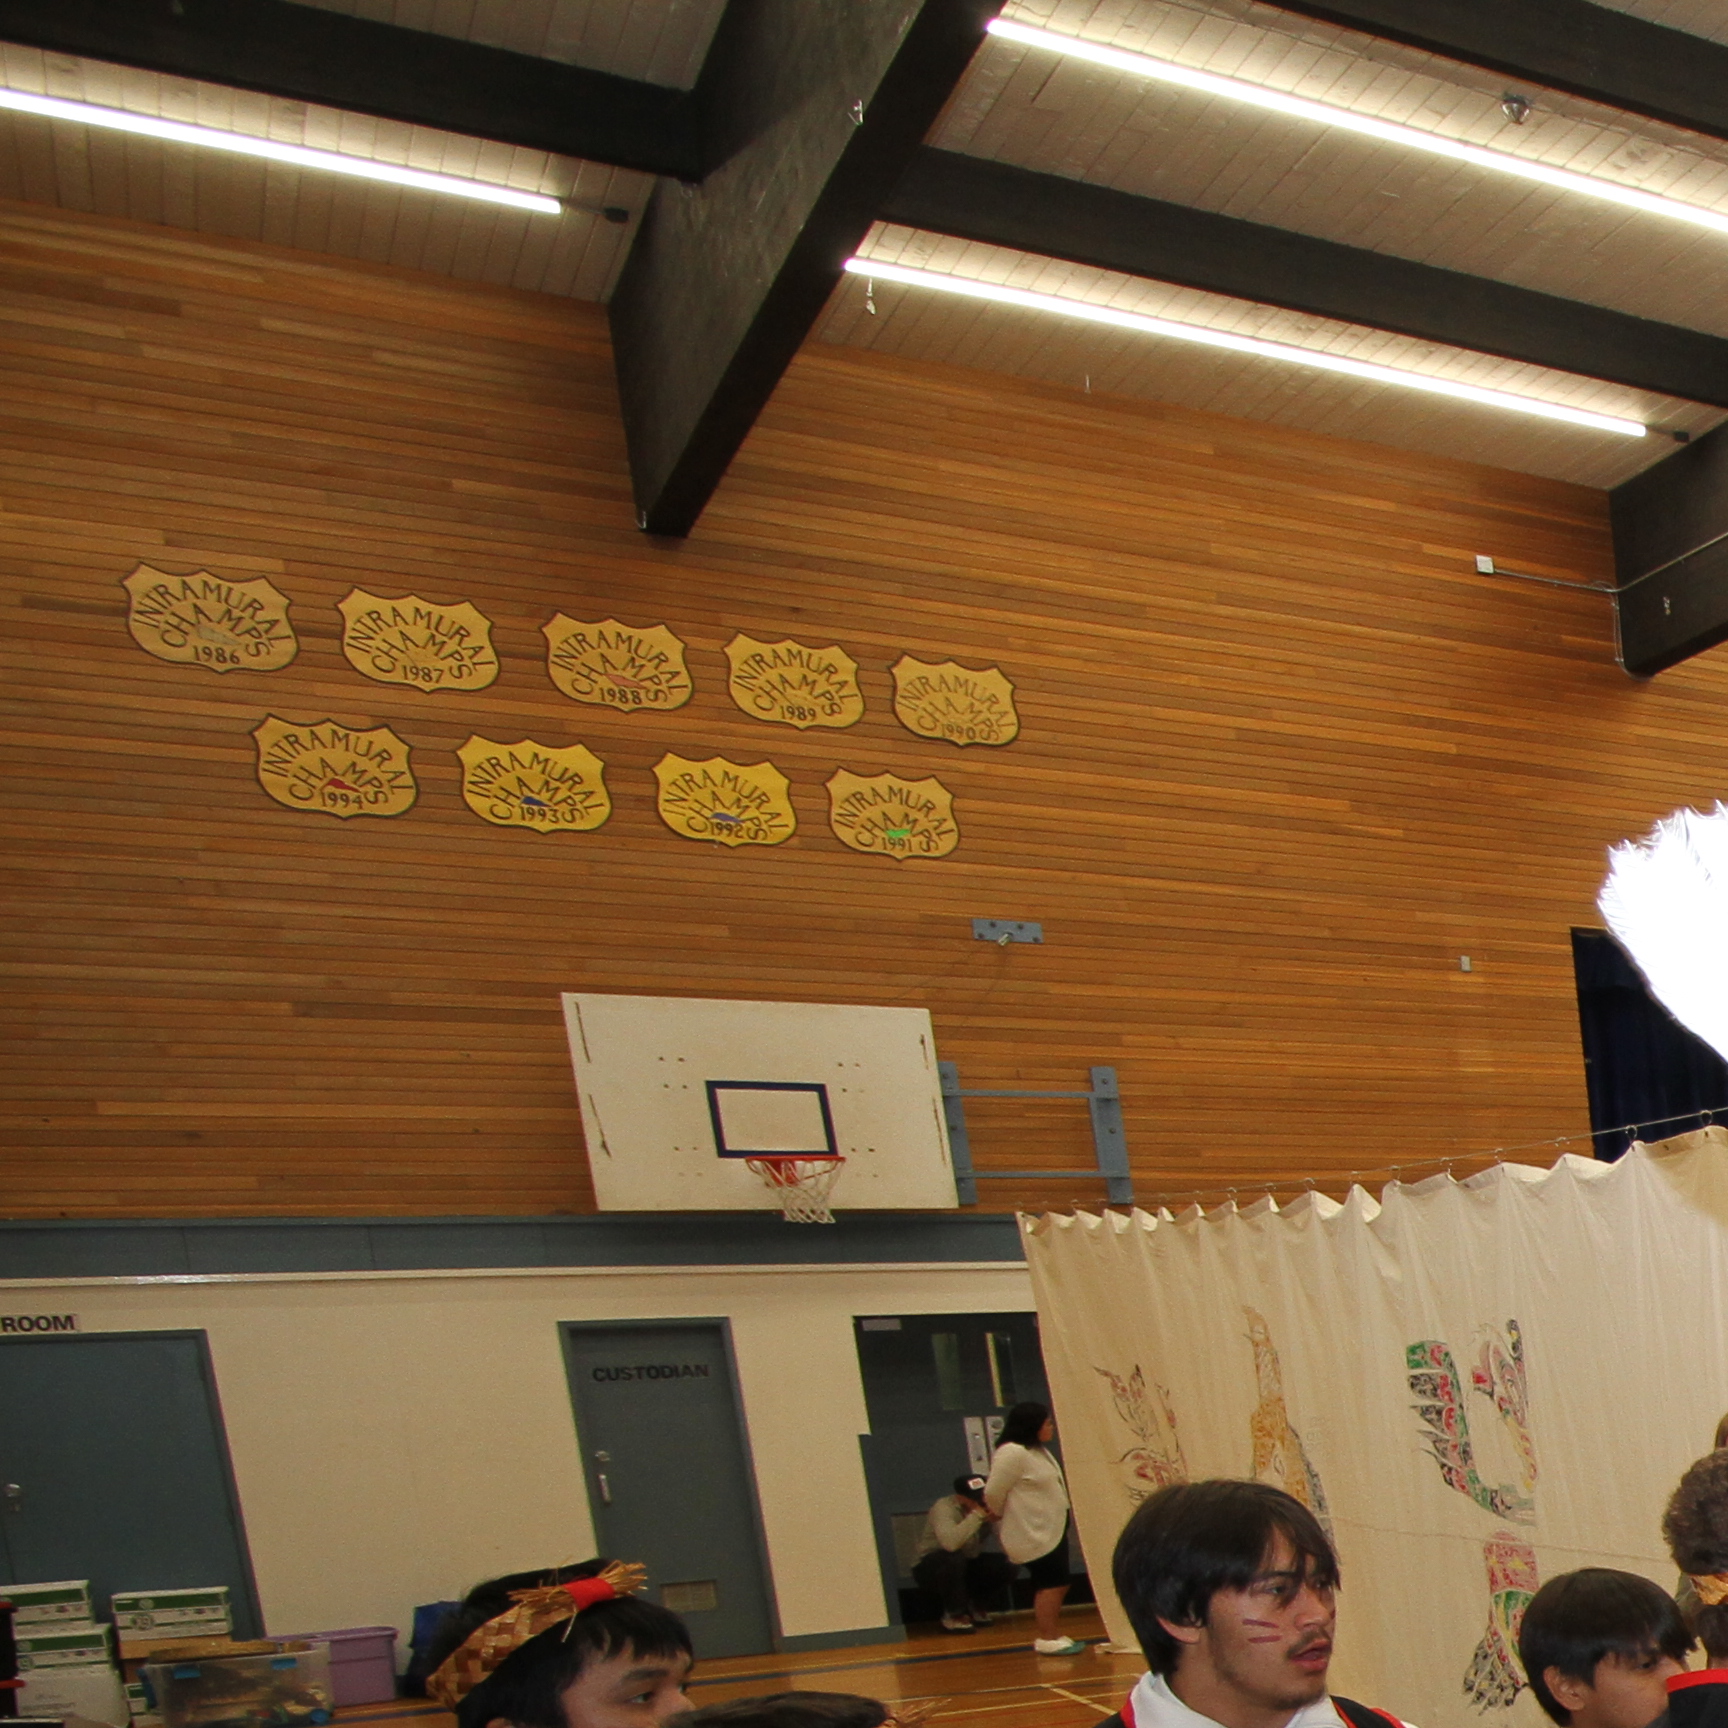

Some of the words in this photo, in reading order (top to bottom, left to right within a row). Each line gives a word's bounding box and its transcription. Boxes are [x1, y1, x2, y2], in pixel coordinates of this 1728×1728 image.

[135, 579, 292, 648] INTRAMURAL
[161, 603, 270, 658] CHAMPS
[346, 606, 495, 670] INTRAMURAL
[192, 644, 240, 666] 1986
[372, 629, 472, 681] CHAMPS
[401, 664, 443, 684] 1987
[552, 629, 689, 695] INTRAMURAL
[571, 652, 668, 704] CHAMPS
[733, 645, 858, 705] INTRAMURAL
[600, 687, 642, 705] 1988
[753, 674, 842, 717] CHAMPS
[779, 704, 817, 721] 1989
[898, 675, 1016, 731] INTRAMURAL
[916, 698, 1000, 743] CHAMPS
[941, 722, 977, 740] 1990
[262, 728, 414, 793] INTRAMURAL
[289, 757, 389, 806] CHAMPS
[466, 752, 604, 812] INTRAMURAL
[319, 791, 364, 810] 1994
[489, 776, 583, 825] CHAMPS
[519, 805, 559, 824] 1993
[663, 761, 789, 835] INTRAMURAL
[686, 791, 769, 843] CHAMPS
[834, 784, 956, 843] INTRAMURAL
[709, 821, 744, 838] 1992
[855, 813, 939, 854] CHAMPS
[880, 836, 914, 853] 1991
[1, 1315, 76, 1333] ROOM
[591, 1364, 710, 1382] CUSTODIAN
